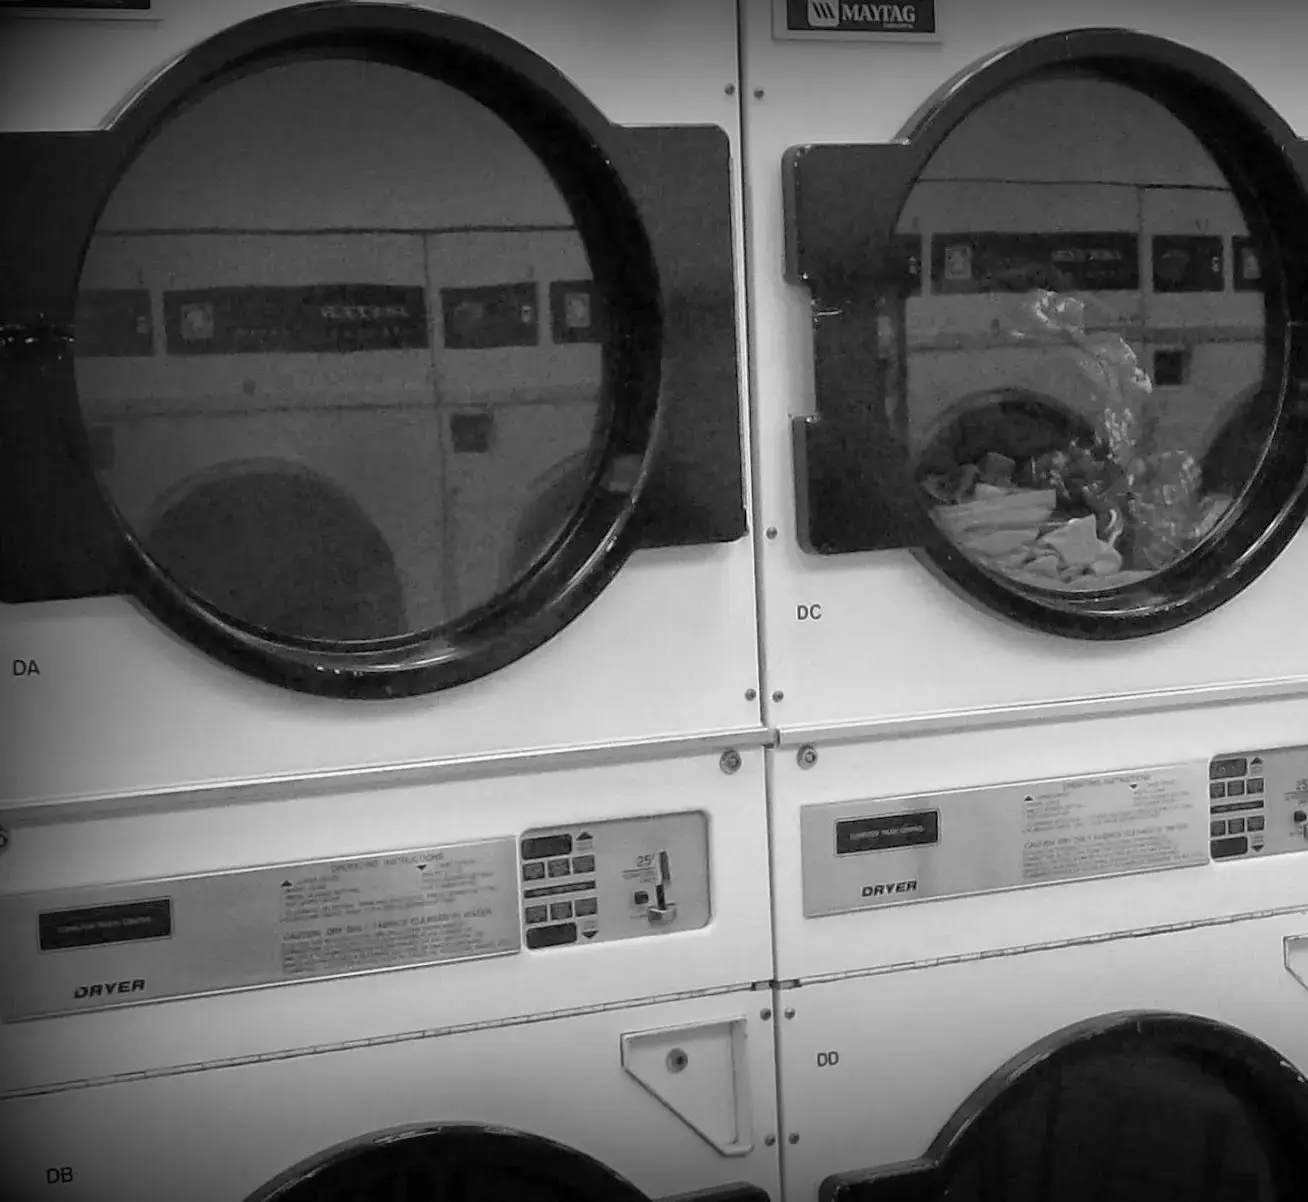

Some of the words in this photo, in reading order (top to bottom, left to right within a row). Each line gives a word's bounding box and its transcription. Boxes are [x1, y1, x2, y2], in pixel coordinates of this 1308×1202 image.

[841, 4, 916, 23] MAYTAG
[797, 604, 822, 620] DC
[12, 659, 41, 676] DA
[861, 880, 918, 897] DRYER
[74, 979, 146, 999] DRYER
[816, 1051, 840, 1067] DD
[46, 1166, 74, 1184] DB
